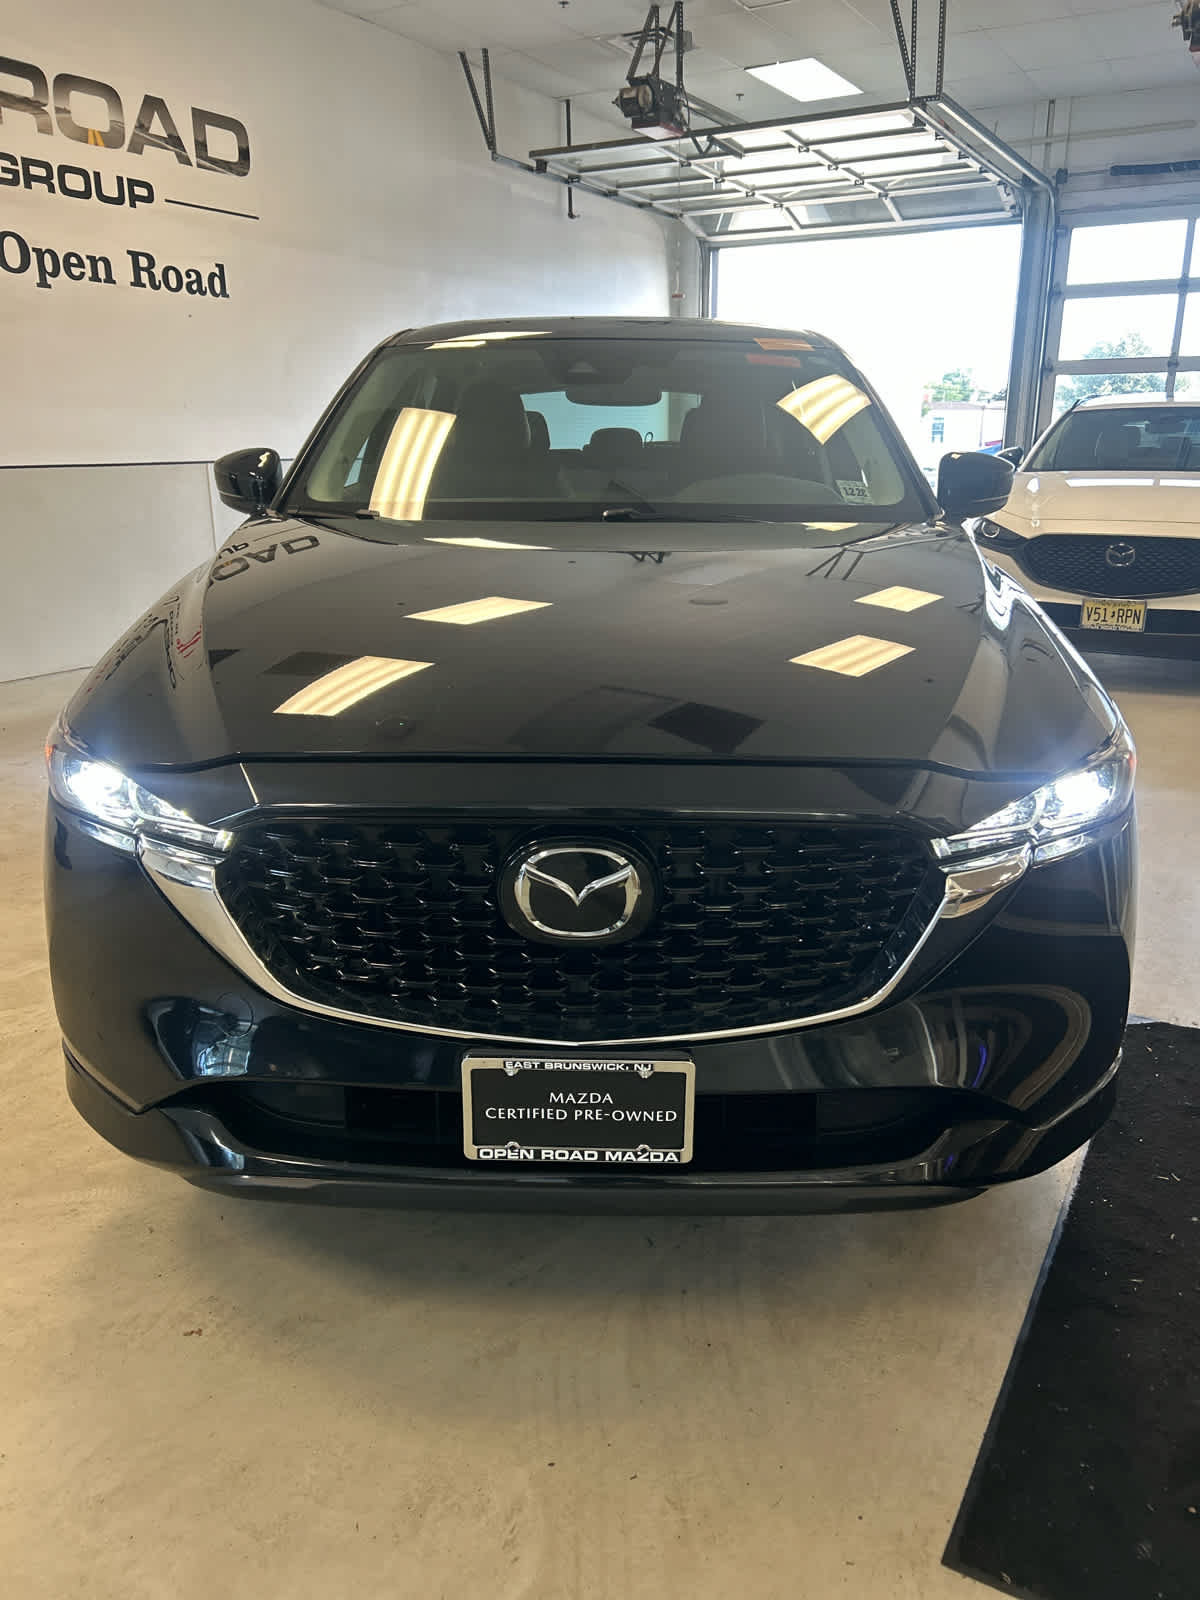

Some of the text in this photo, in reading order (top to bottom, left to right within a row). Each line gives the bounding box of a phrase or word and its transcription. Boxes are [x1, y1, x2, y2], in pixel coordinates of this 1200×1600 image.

[0, 55, 251, 177] ROAD
[0, 152, 155, 208] GROUP
[0, 230, 230, 299] Open Road
[1086, 606, 1141, 625] V51 RPN
[505, 1061, 540, 1070] EAST
[634, 1063, 652, 1072] NJ
[549, 1092, 614, 1105] MAZDA
[485, 1107, 678, 1122] CERTIFIED PRE-OWNED
[479, 1148, 679, 1163] OPEN ROAD MAZDA
